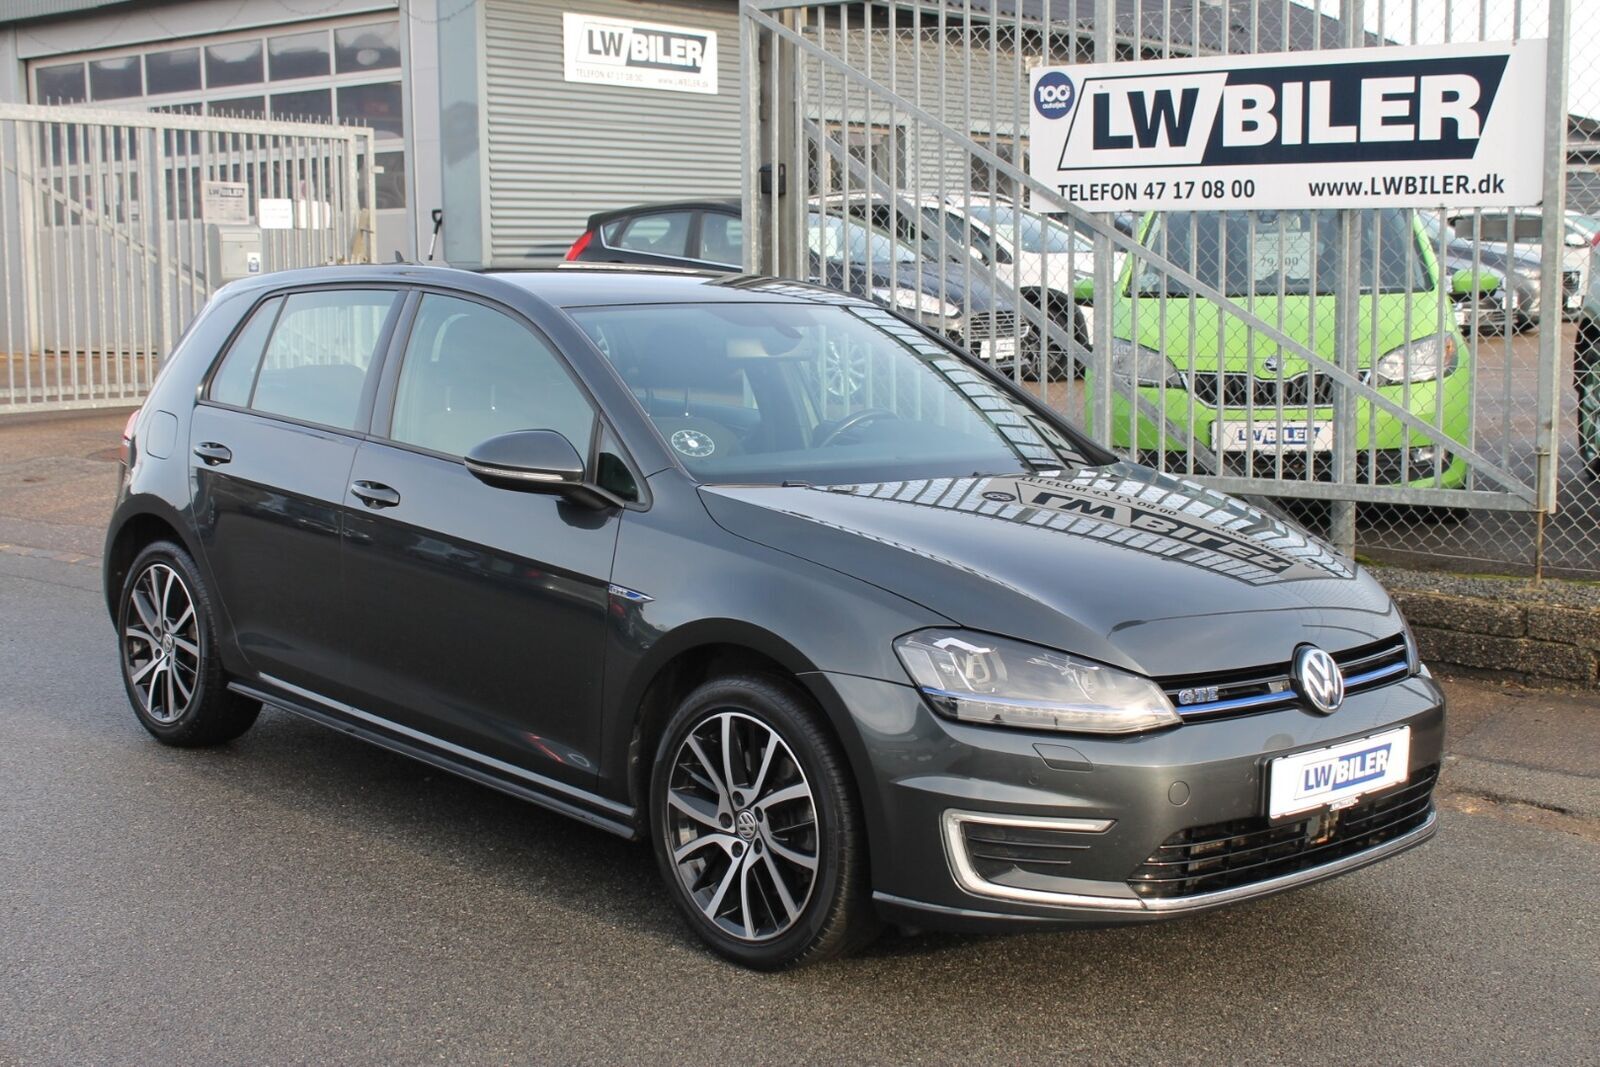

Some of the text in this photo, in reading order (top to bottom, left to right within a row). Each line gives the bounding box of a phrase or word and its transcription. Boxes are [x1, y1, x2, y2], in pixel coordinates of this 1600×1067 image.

[1057, 179, 1256, 201] TELEFON 47 17 08 00
[1308, 173, 1505, 197] www.LWBILER.dk
[1179, 687, 1219, 705] GTE
